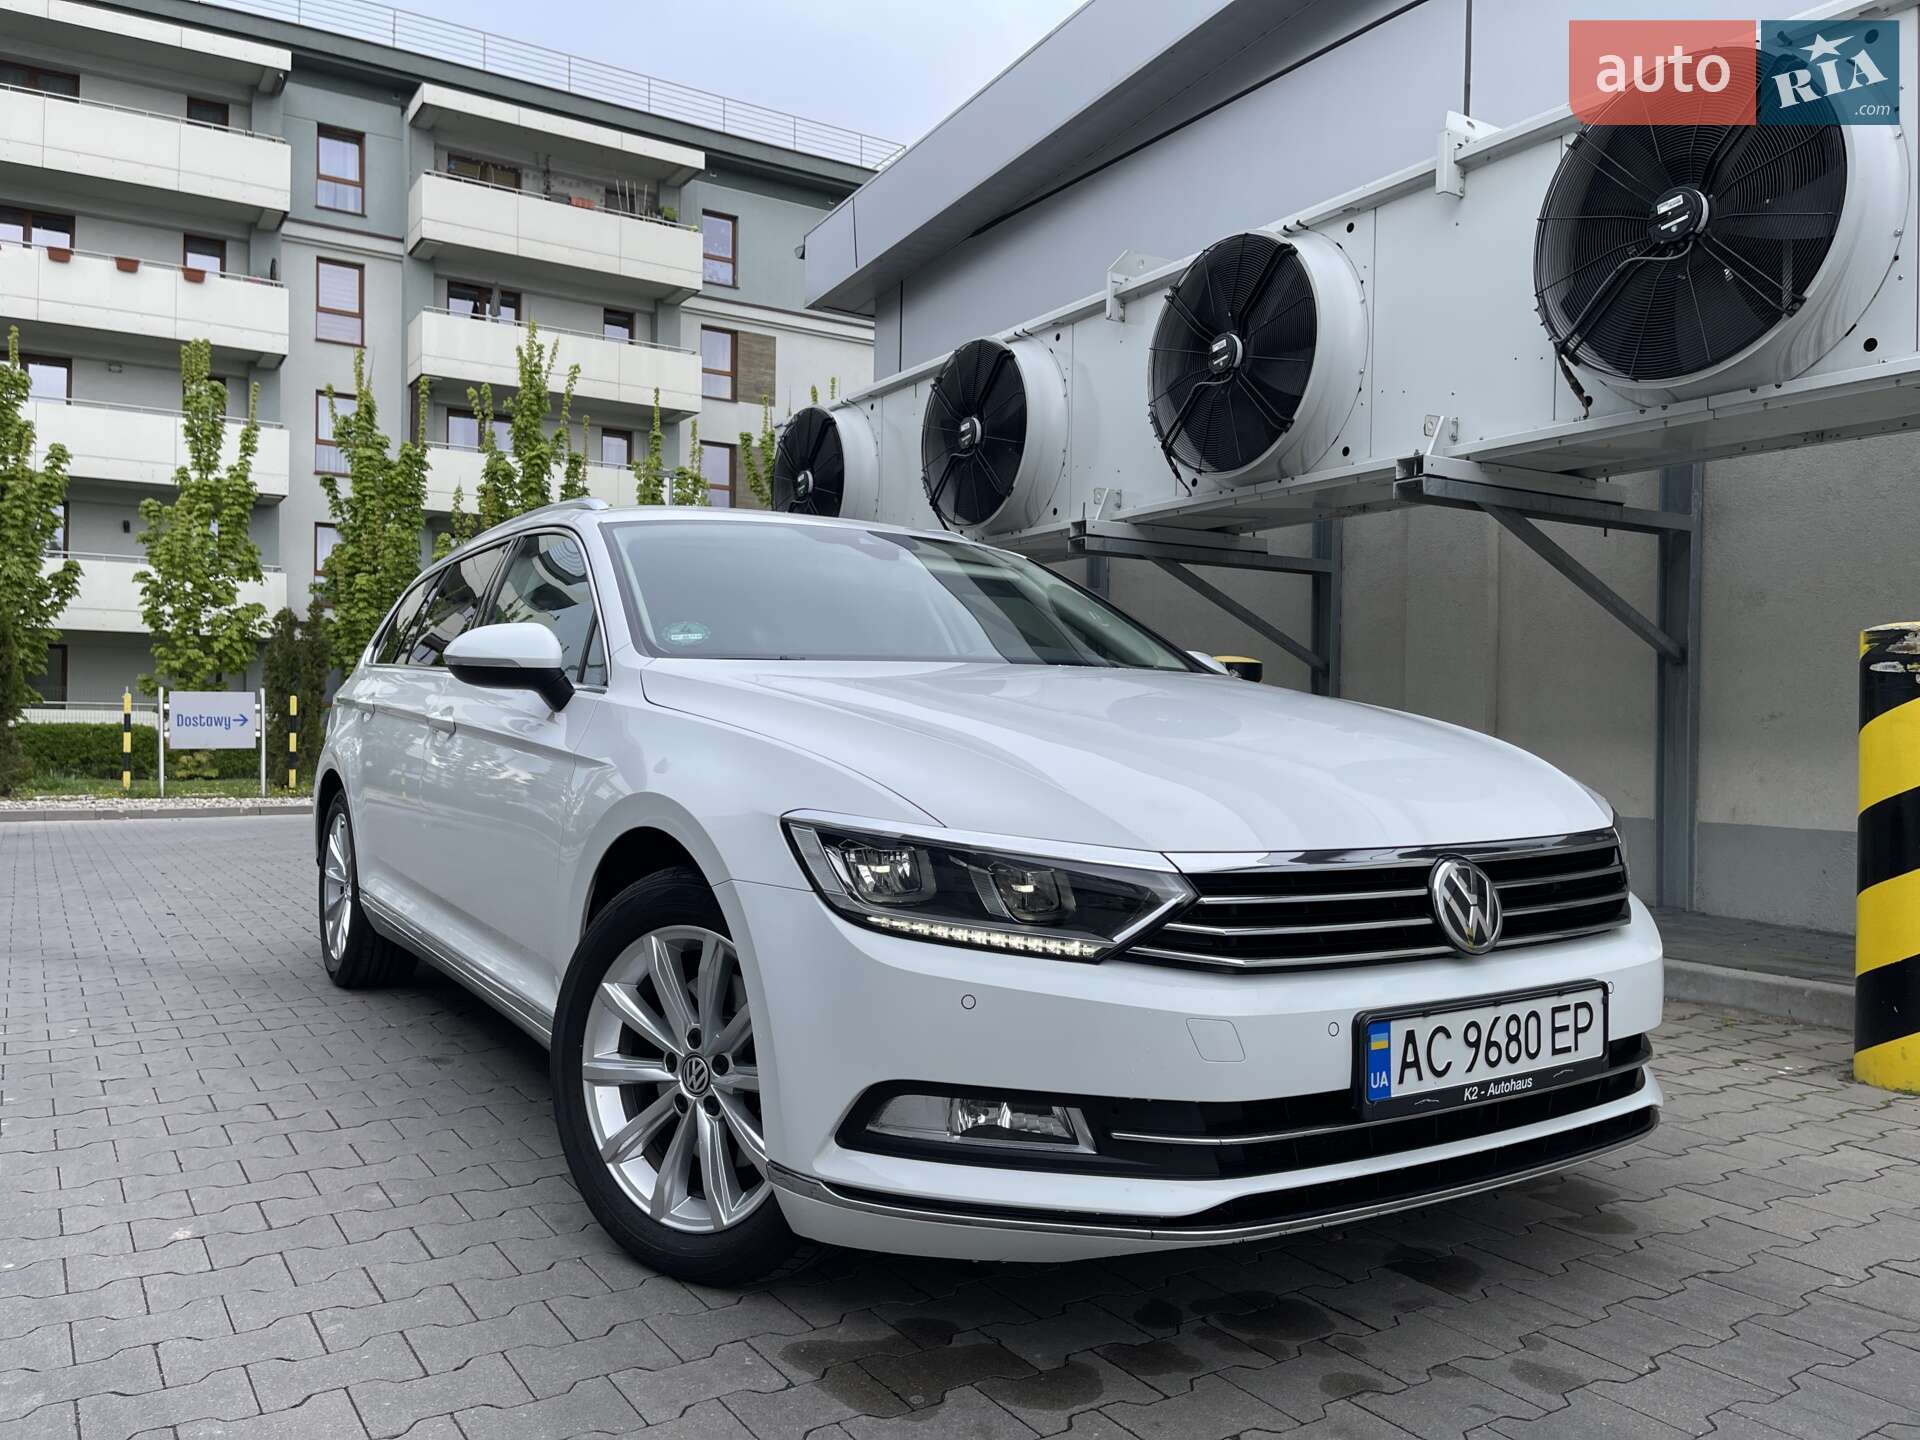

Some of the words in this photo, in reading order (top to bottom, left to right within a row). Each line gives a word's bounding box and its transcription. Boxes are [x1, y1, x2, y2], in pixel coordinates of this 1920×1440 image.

[177, 714, 231, 730] Dostawy
[1398, 1025, 1453, 1085] AC
[1463, 1010, 1541, 1073] 9680
[1551, 1001, 1594, 1056] EP
[1371, 1071, 1389, 1089] UA
[1464, 1087, 1478, 1101] K2
[1487, 1076, 1533, 1096] Autohaus
